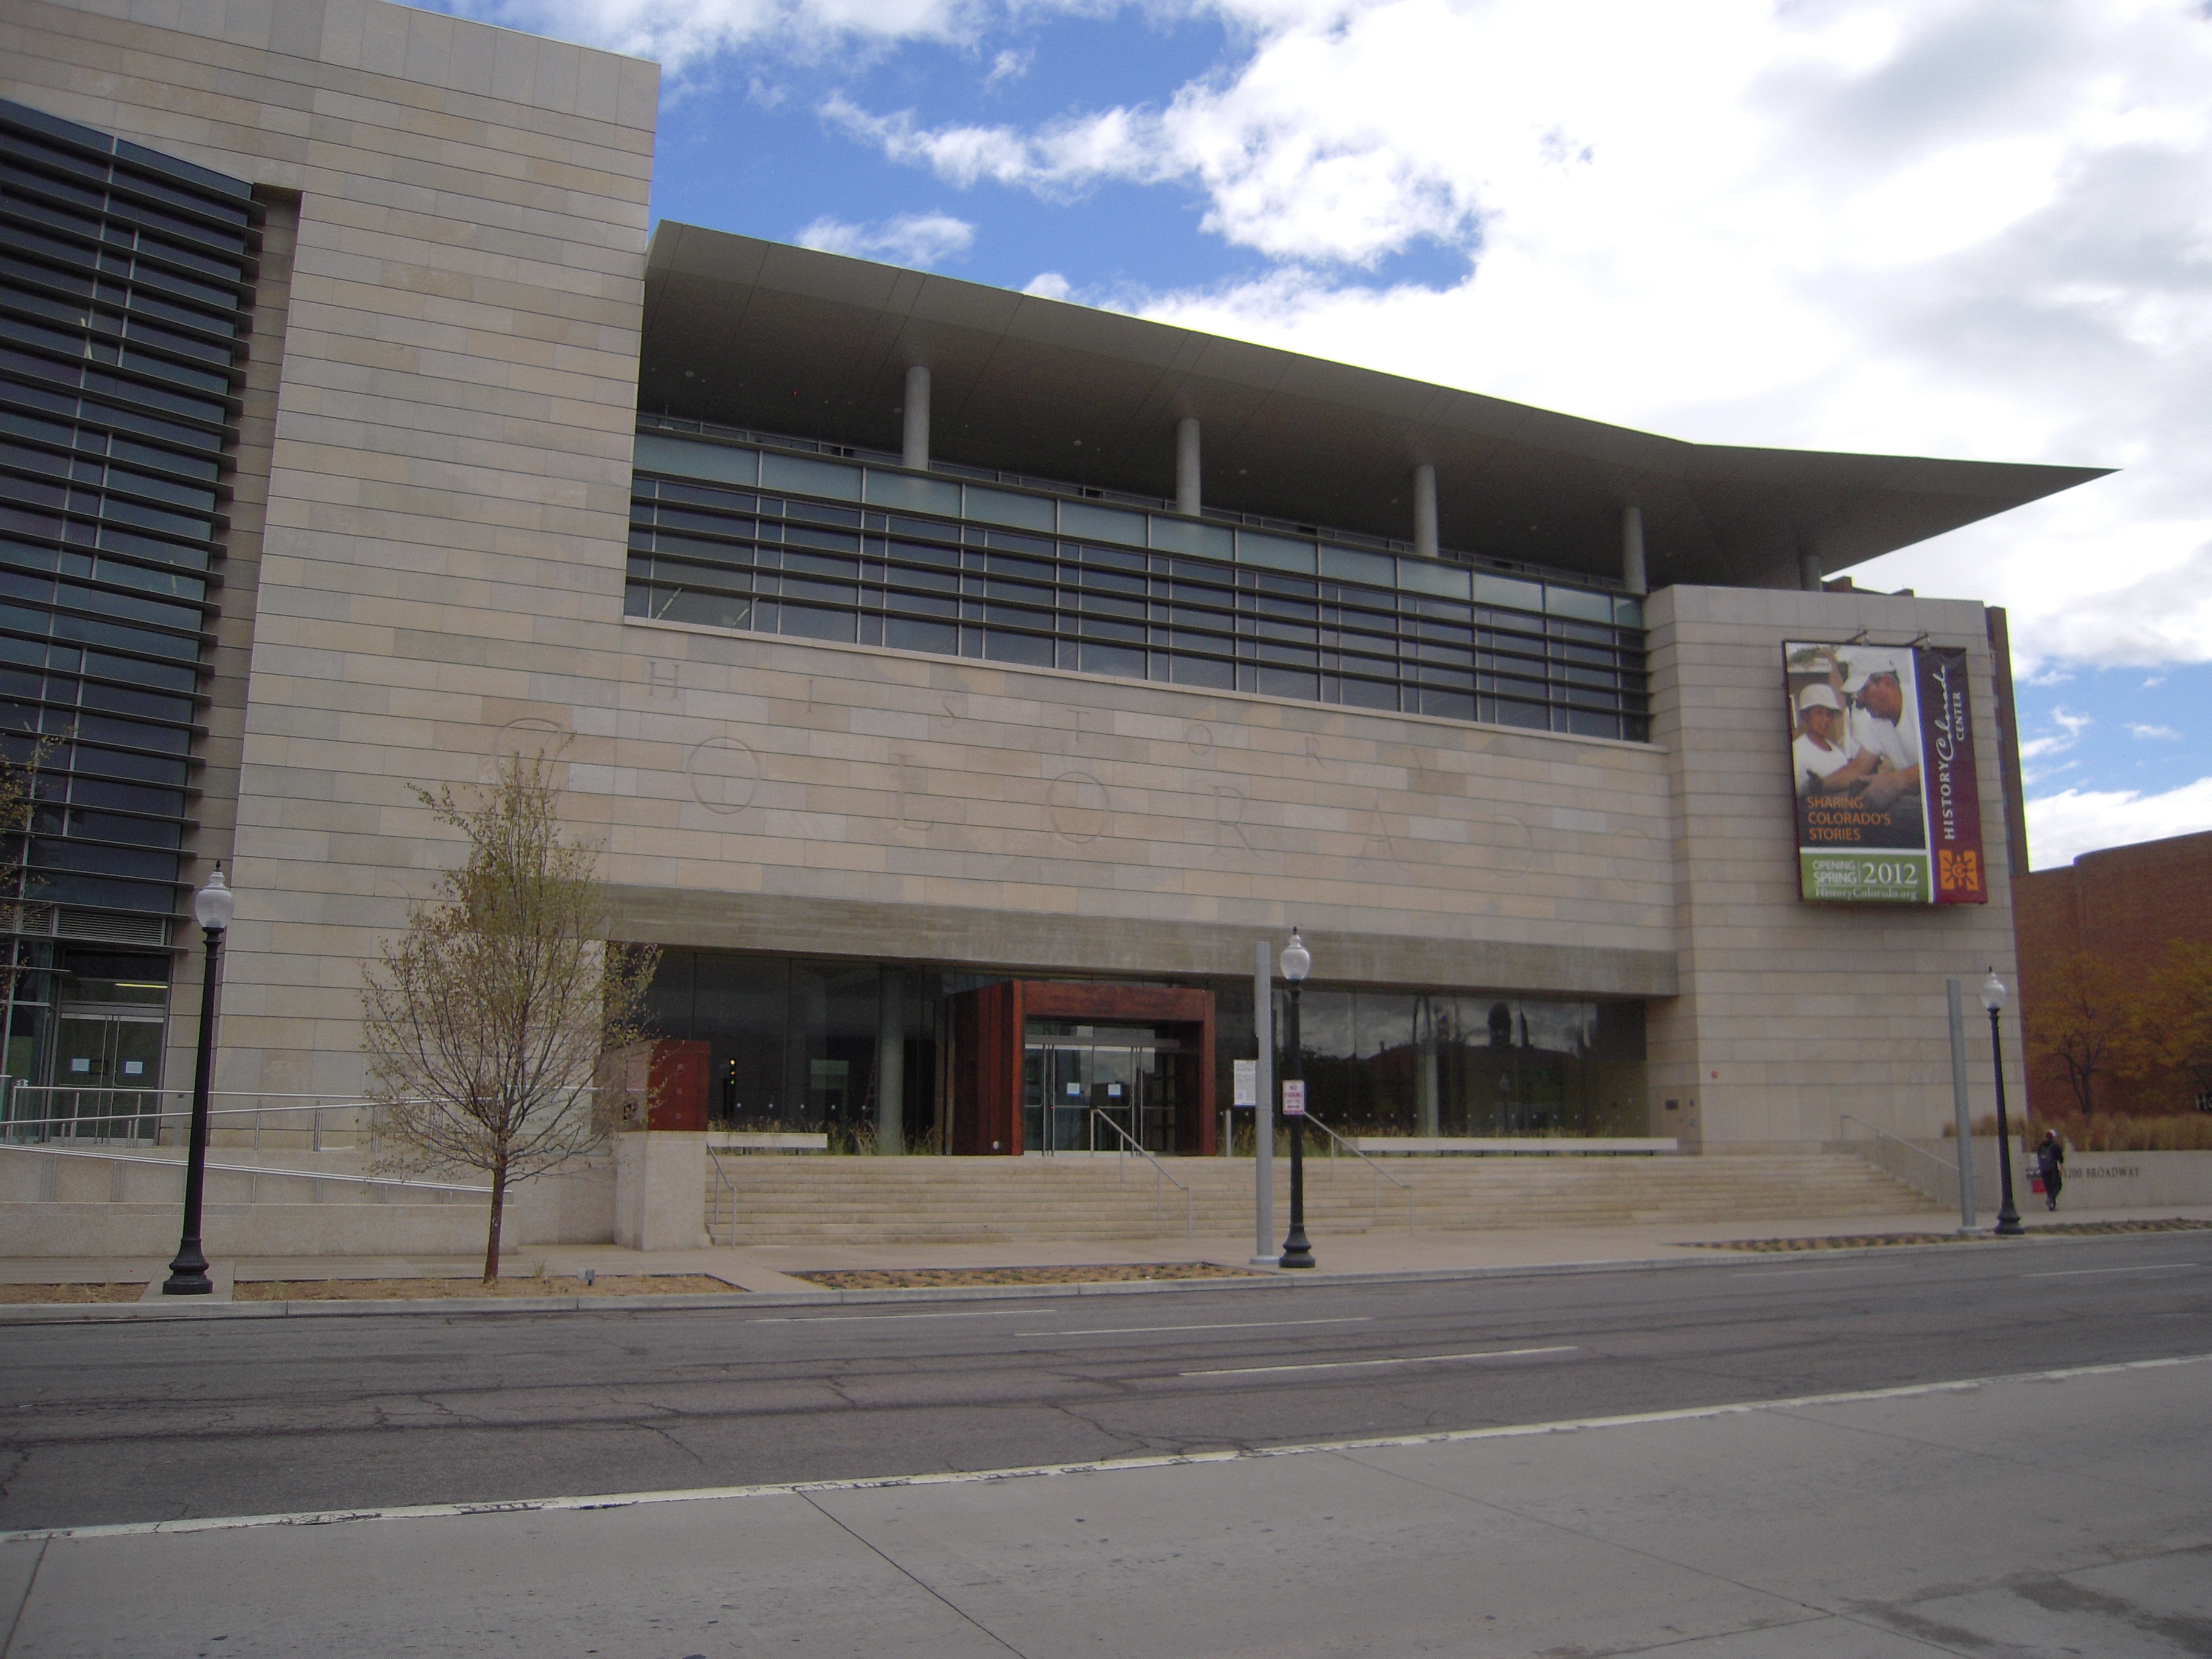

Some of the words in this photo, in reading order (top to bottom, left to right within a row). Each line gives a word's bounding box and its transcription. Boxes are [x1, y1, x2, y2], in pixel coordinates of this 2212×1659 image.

[647, 662, 1432, 780] HISTORY
[1932, 665, 1954, 761] Colorado
[1952, 692, 1965, 743] CENTER
[492, 717, 1649, 890] COLORADO
[1807, 796, 1864, 809] SHARING
[1939, 762, 1955, 840] HISTORY
[1808, 811, 1891, 825] COLORADO'S
[1809, 828, 1861, 841] STORIES
[1812, 860, 1855, 870] OPENING
[1814, 871, 1856, 885] SPRING
[1862, 862, 1918, 885] 2012
[1815, 887, 1917, 902] HistoryColorado.org
[2085, 1166, 2139, 1178] BROADWAY
